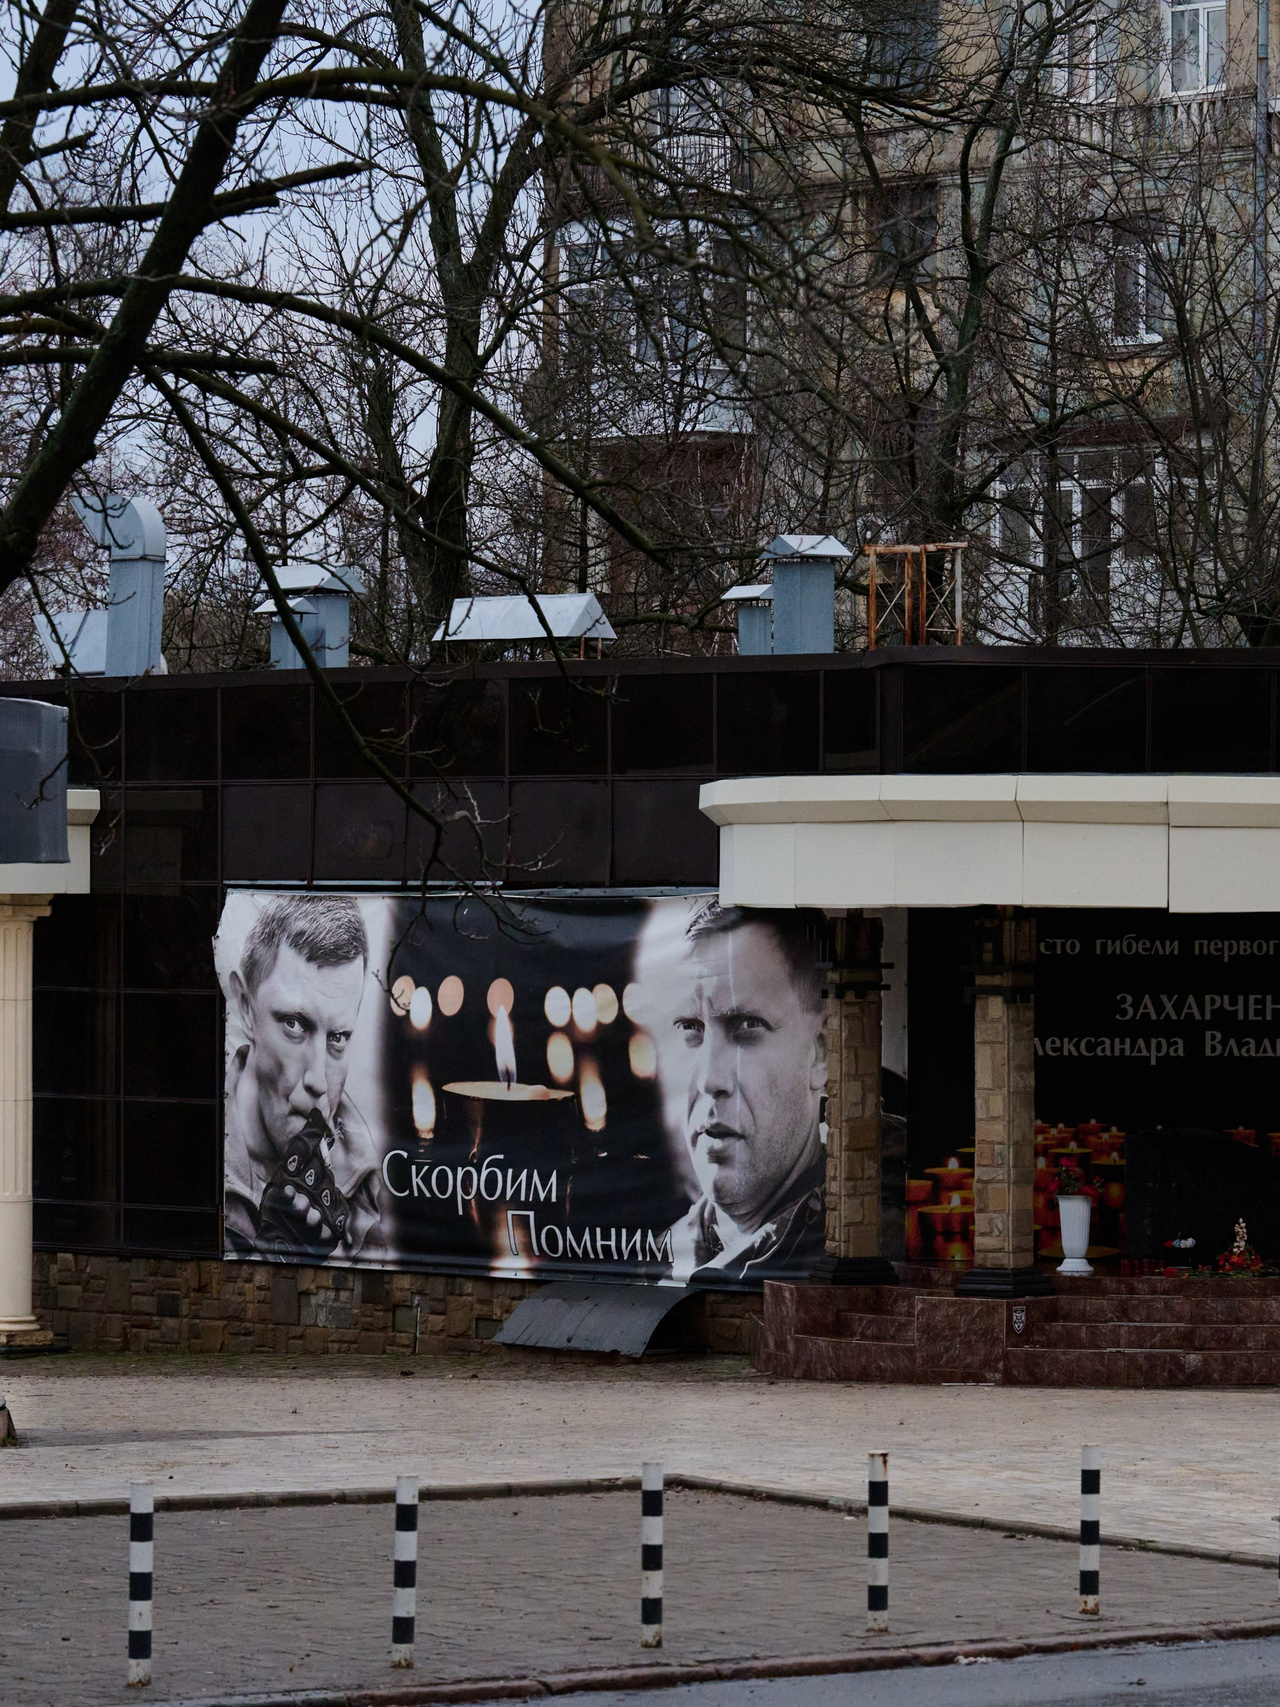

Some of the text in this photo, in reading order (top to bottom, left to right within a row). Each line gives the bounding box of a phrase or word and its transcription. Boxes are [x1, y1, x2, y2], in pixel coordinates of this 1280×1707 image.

[1038, 938, 1081, 956] сто
[1095, 933, 1180, 956] гибели
[1033, 1036, 1185, 1066] лександра
[382, 1149, 558, 1216] Скорбим
[506, 1209, 675, 1264] Помним
